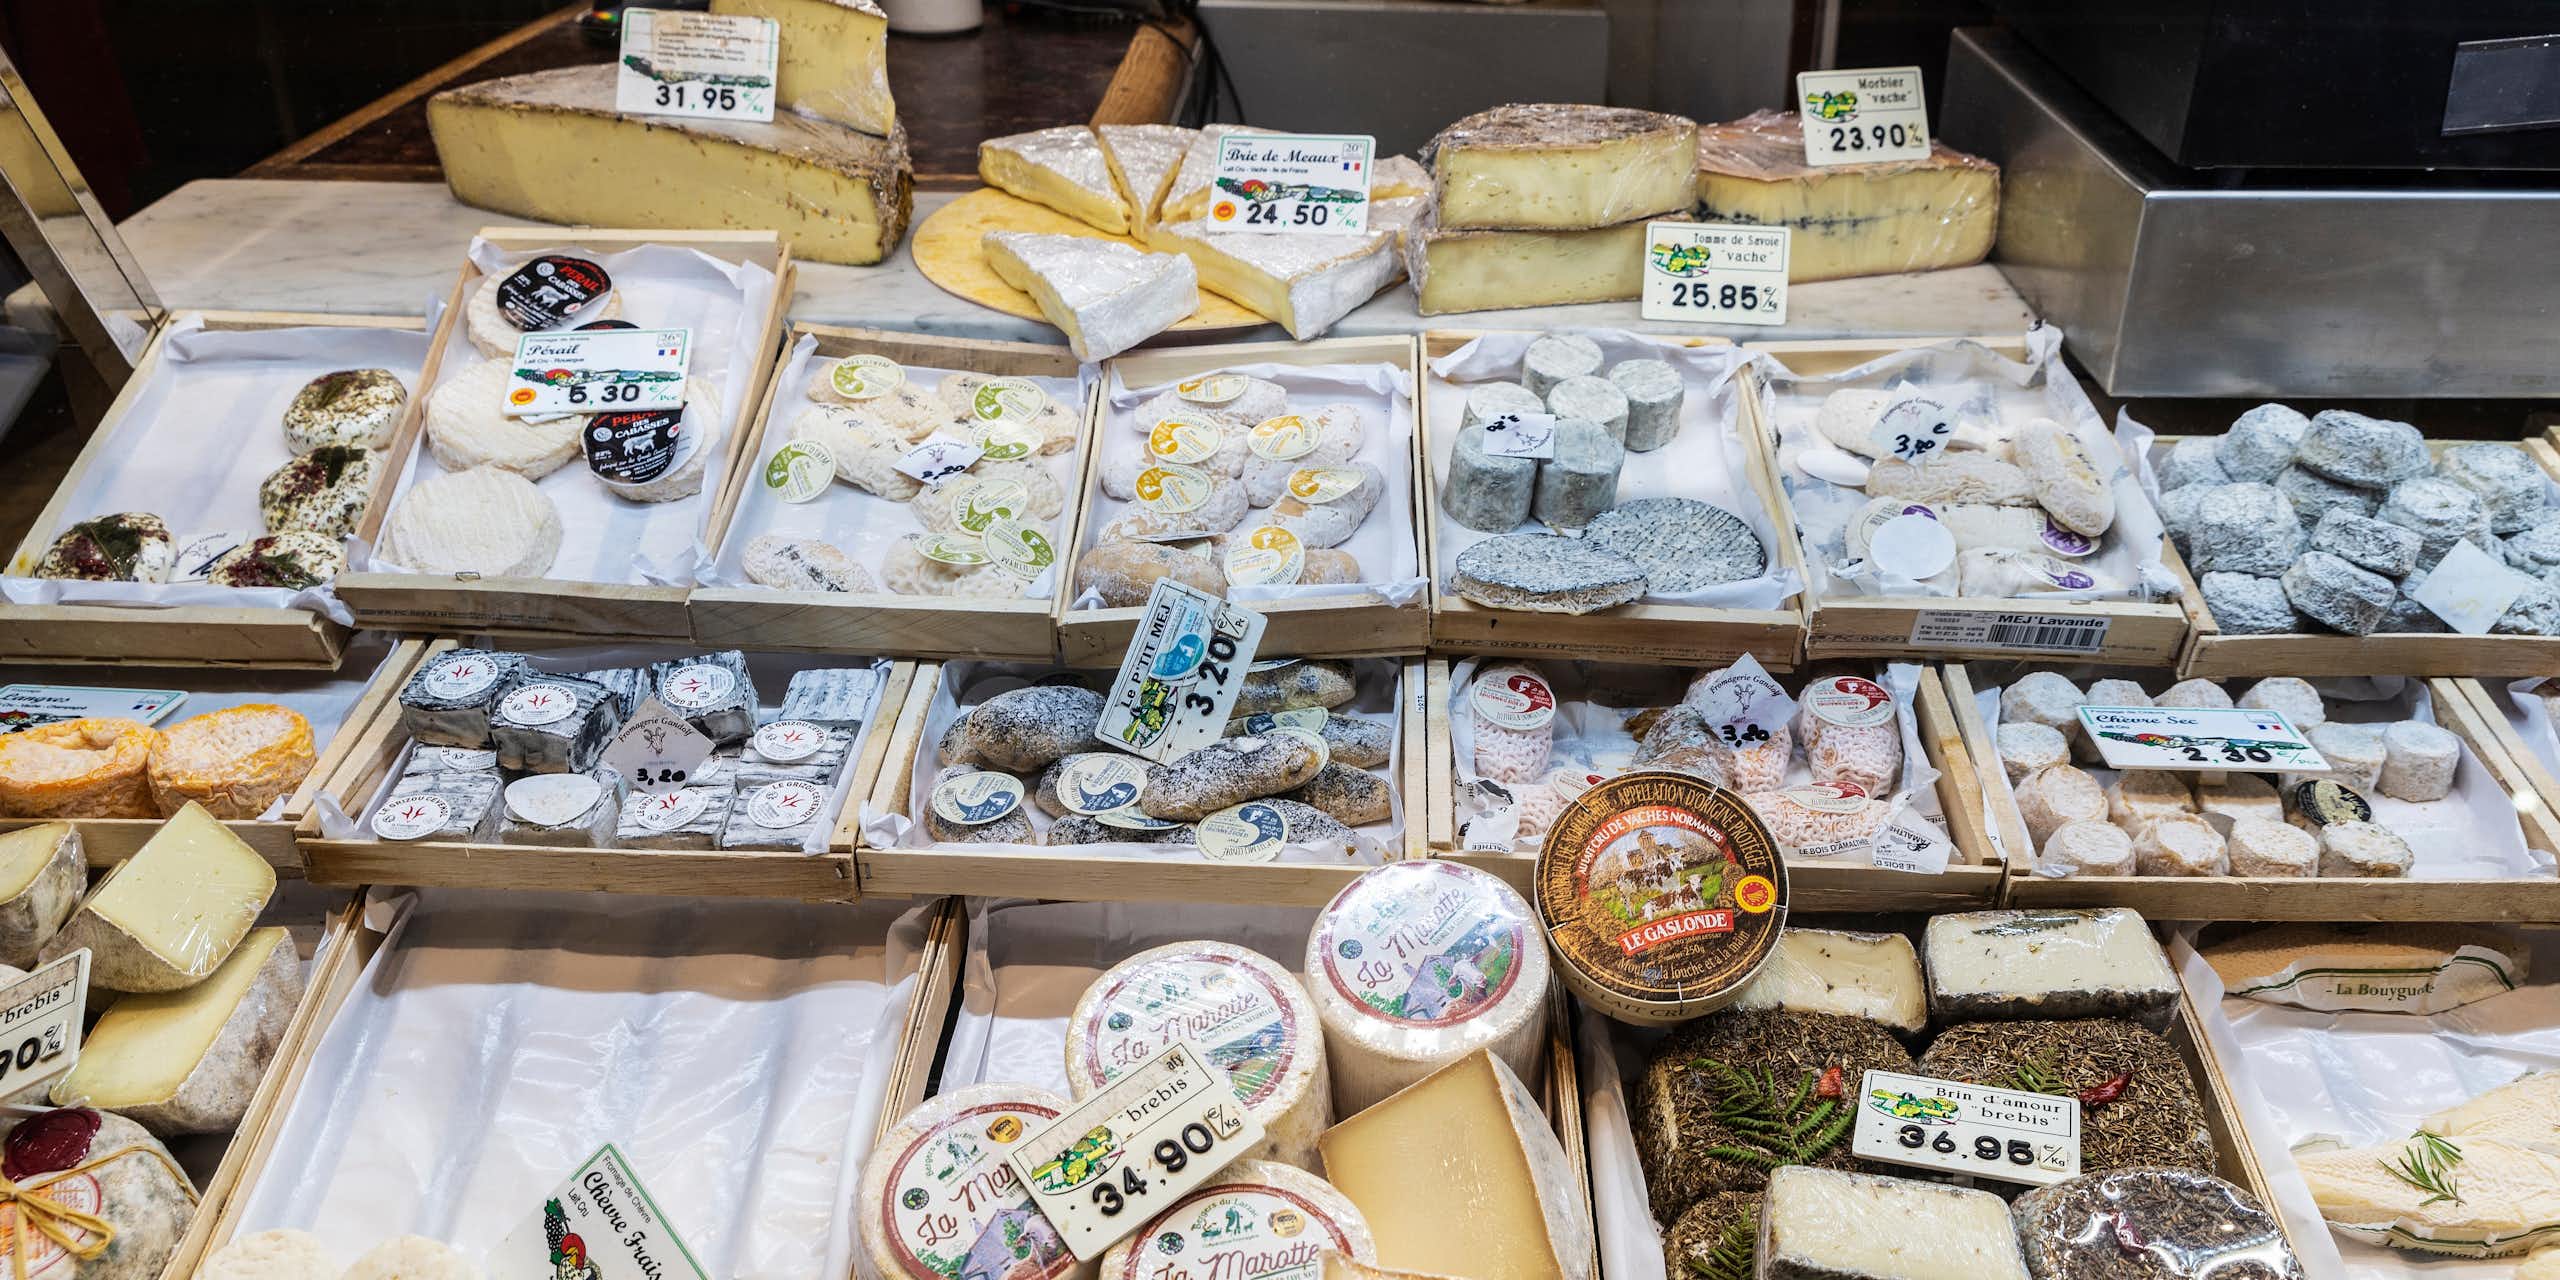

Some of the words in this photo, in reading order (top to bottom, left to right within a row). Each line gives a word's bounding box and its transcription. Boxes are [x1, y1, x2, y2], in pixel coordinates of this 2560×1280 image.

[1858, 77, 1904, 89] Morbier
[655, 85, 736, 111] 31,95
[1225, 149, 1258, 162] Brie
[1262, 150, 1279, 162] de
[1283, 150, 1339, 163] Meaux
[1246, 203, 1328, 226] 24,50
[1694, 233, 1726, 245] Tomme
[1731, 234, 1744, 245] de
[1748, 235, 1779, 247] Savoie
[526, 344, 580, 356] Pérail
[569, 384, 640, 406] 5,30
[615, 417, 670, 439] CABASSES
[632, 418, 650, 428] DES
[1121, 689, 1137, 709] Le
[1131, 642, 1156, 684] P'TIT
[1151, 604, 1172, 639] MEJ
[1186, 636, 1237, 717] 3,20
[1709, 675, 1752, 695] Fromagerie
[618, 716, 659, 742] Fromagerie
[2096, 715, 2161, 724] Chèvre
[2167, 716, 2198, 725] Sec
[2181, 747, 2273, 764] 2,30
[1607, 822, 1625, 835] DE
[1617, 781, 1684, 806] APPELLATION
[1687, 788, 1736, 829] D'ORIGINE
[1734, 821, 1768, 870] PROTÉGÉE
[1624, 810, 1669, 826] VACHES
[1669, 812, 1724, 843] NORMANDES
[1591, 832, 1610, 850] CRU
[1798, 847, 1808, 855] LE
[1809, 845, 1829, 855] BOIS
[1581, 846, 1596, 865] LAIT
[1579, 865, 1588, 875] AU
[1622, 934, 1645, 951] LE
[1644, 913, 1728, 942] GASLONDE
[1671, 962, 1704, 980] louche
[1705, 958, 1714, 969] et
[1722, 947, 1730, 961] la
[1728, 930, 1750, 953] main
[1357, 959, 1393, 989] La
[2336, 983, 2353, 995] La
[1650, 1003, 1693, 1018] CRU
[1111, 1037, 1149, 1067] La
[1936, 1087, 1972, 1100] Brin
[1983, 1095, 2062, 1114] d'amour
[1899, 1124, 2035, 1166] 36,95
[1092, 1121, 1214, 1217] 34,90
[602, 1155, 627, 1189] Fromage
[624, 1187, 634, 1199] de
[631, 1196, 652, 1224] Chèvre
[567, 1187, 582, 1202] Lait
[576, 1200, 590, 1217] Cru
[1219, 1198, 1231, 1206] du
[583, 1170, 628, 1234] Chèvre
[623, 1230, 666, 1280] Frais
[917, 1213, 959, 1247] La
[1198, 1241, 1320, 1280] Marotte
